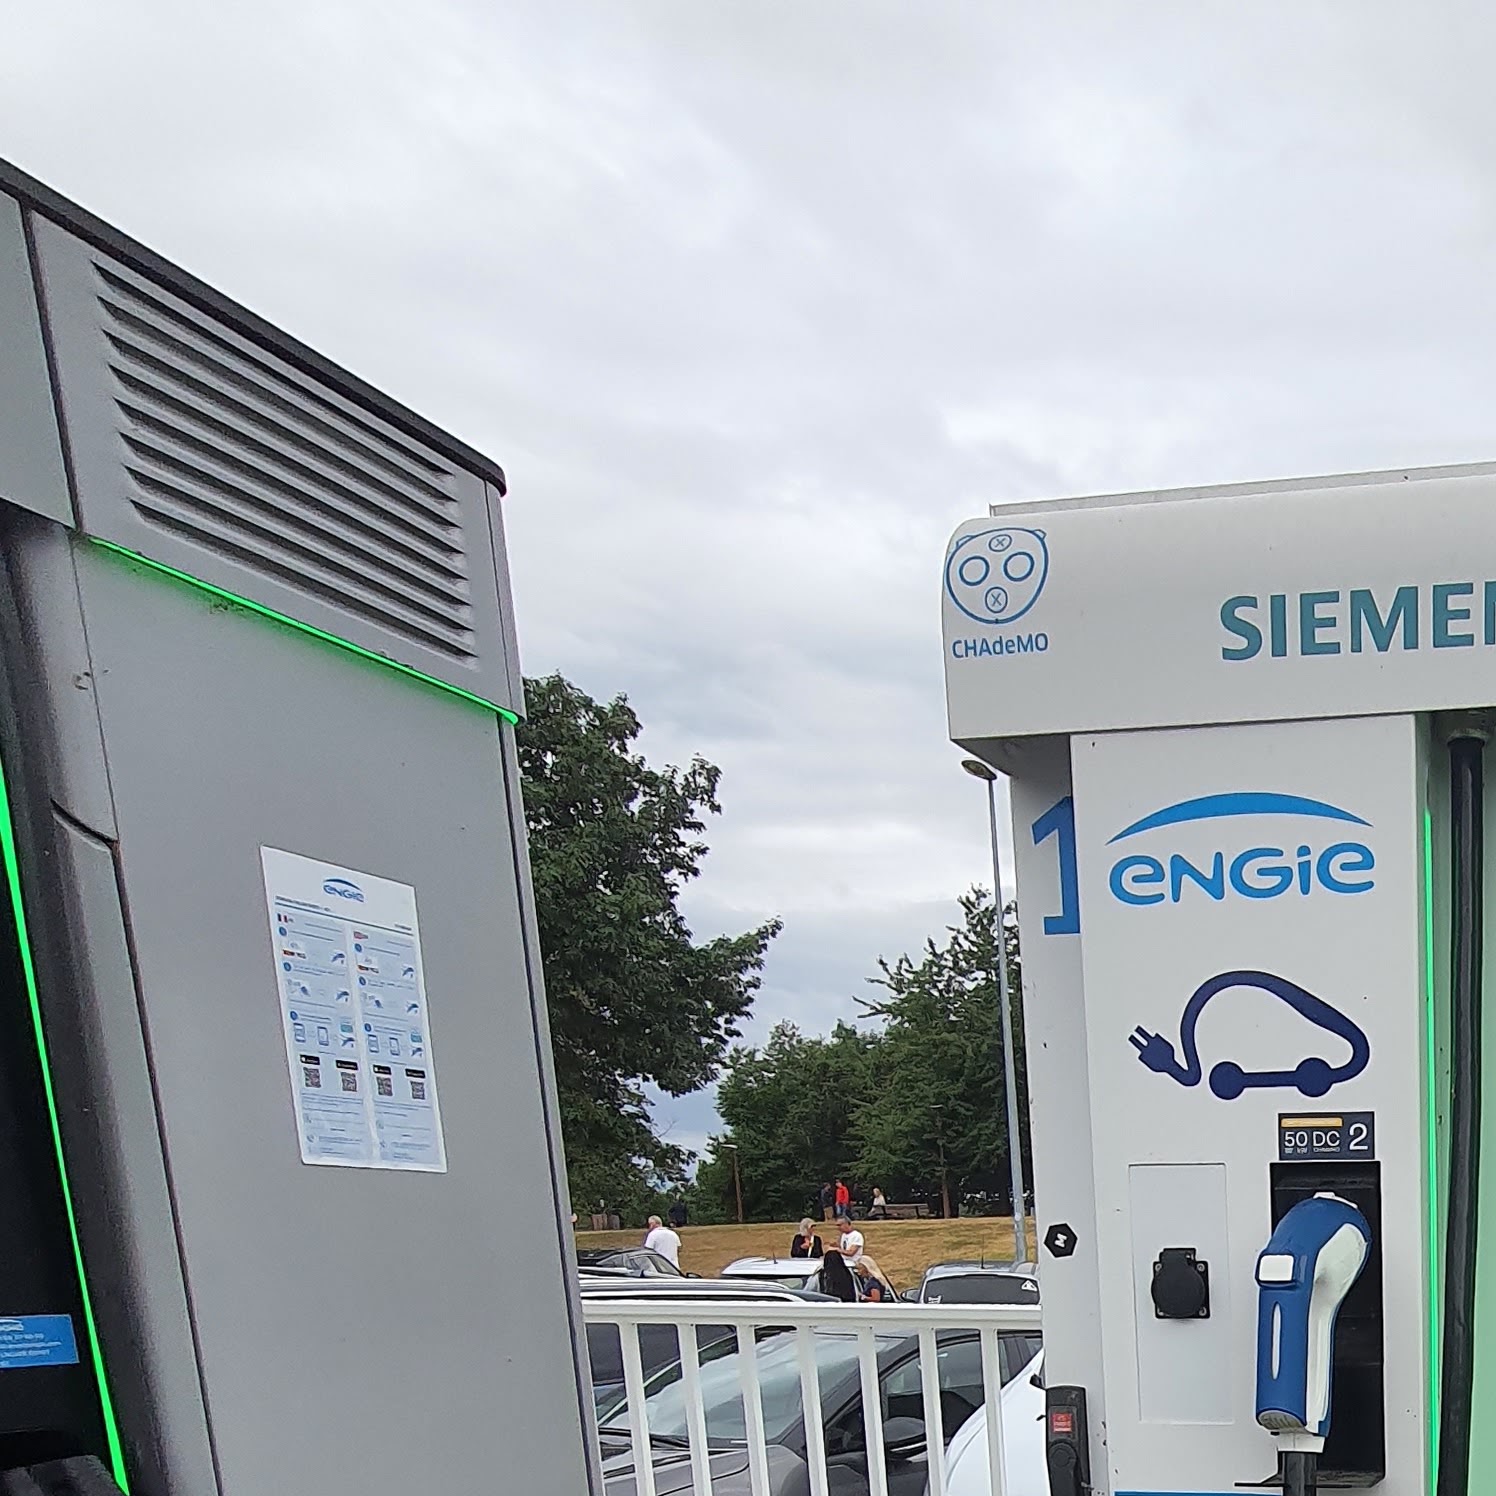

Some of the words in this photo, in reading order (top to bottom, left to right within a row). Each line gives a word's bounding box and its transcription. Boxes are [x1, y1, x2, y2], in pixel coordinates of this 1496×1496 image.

[951, 632, 1050, 659] CHAdeMO
[1284, 1131, 1308, 1147] 50
[1312, 1131, 1341, 1147] DC
[1348, 1122, 1369, 1151] 2
